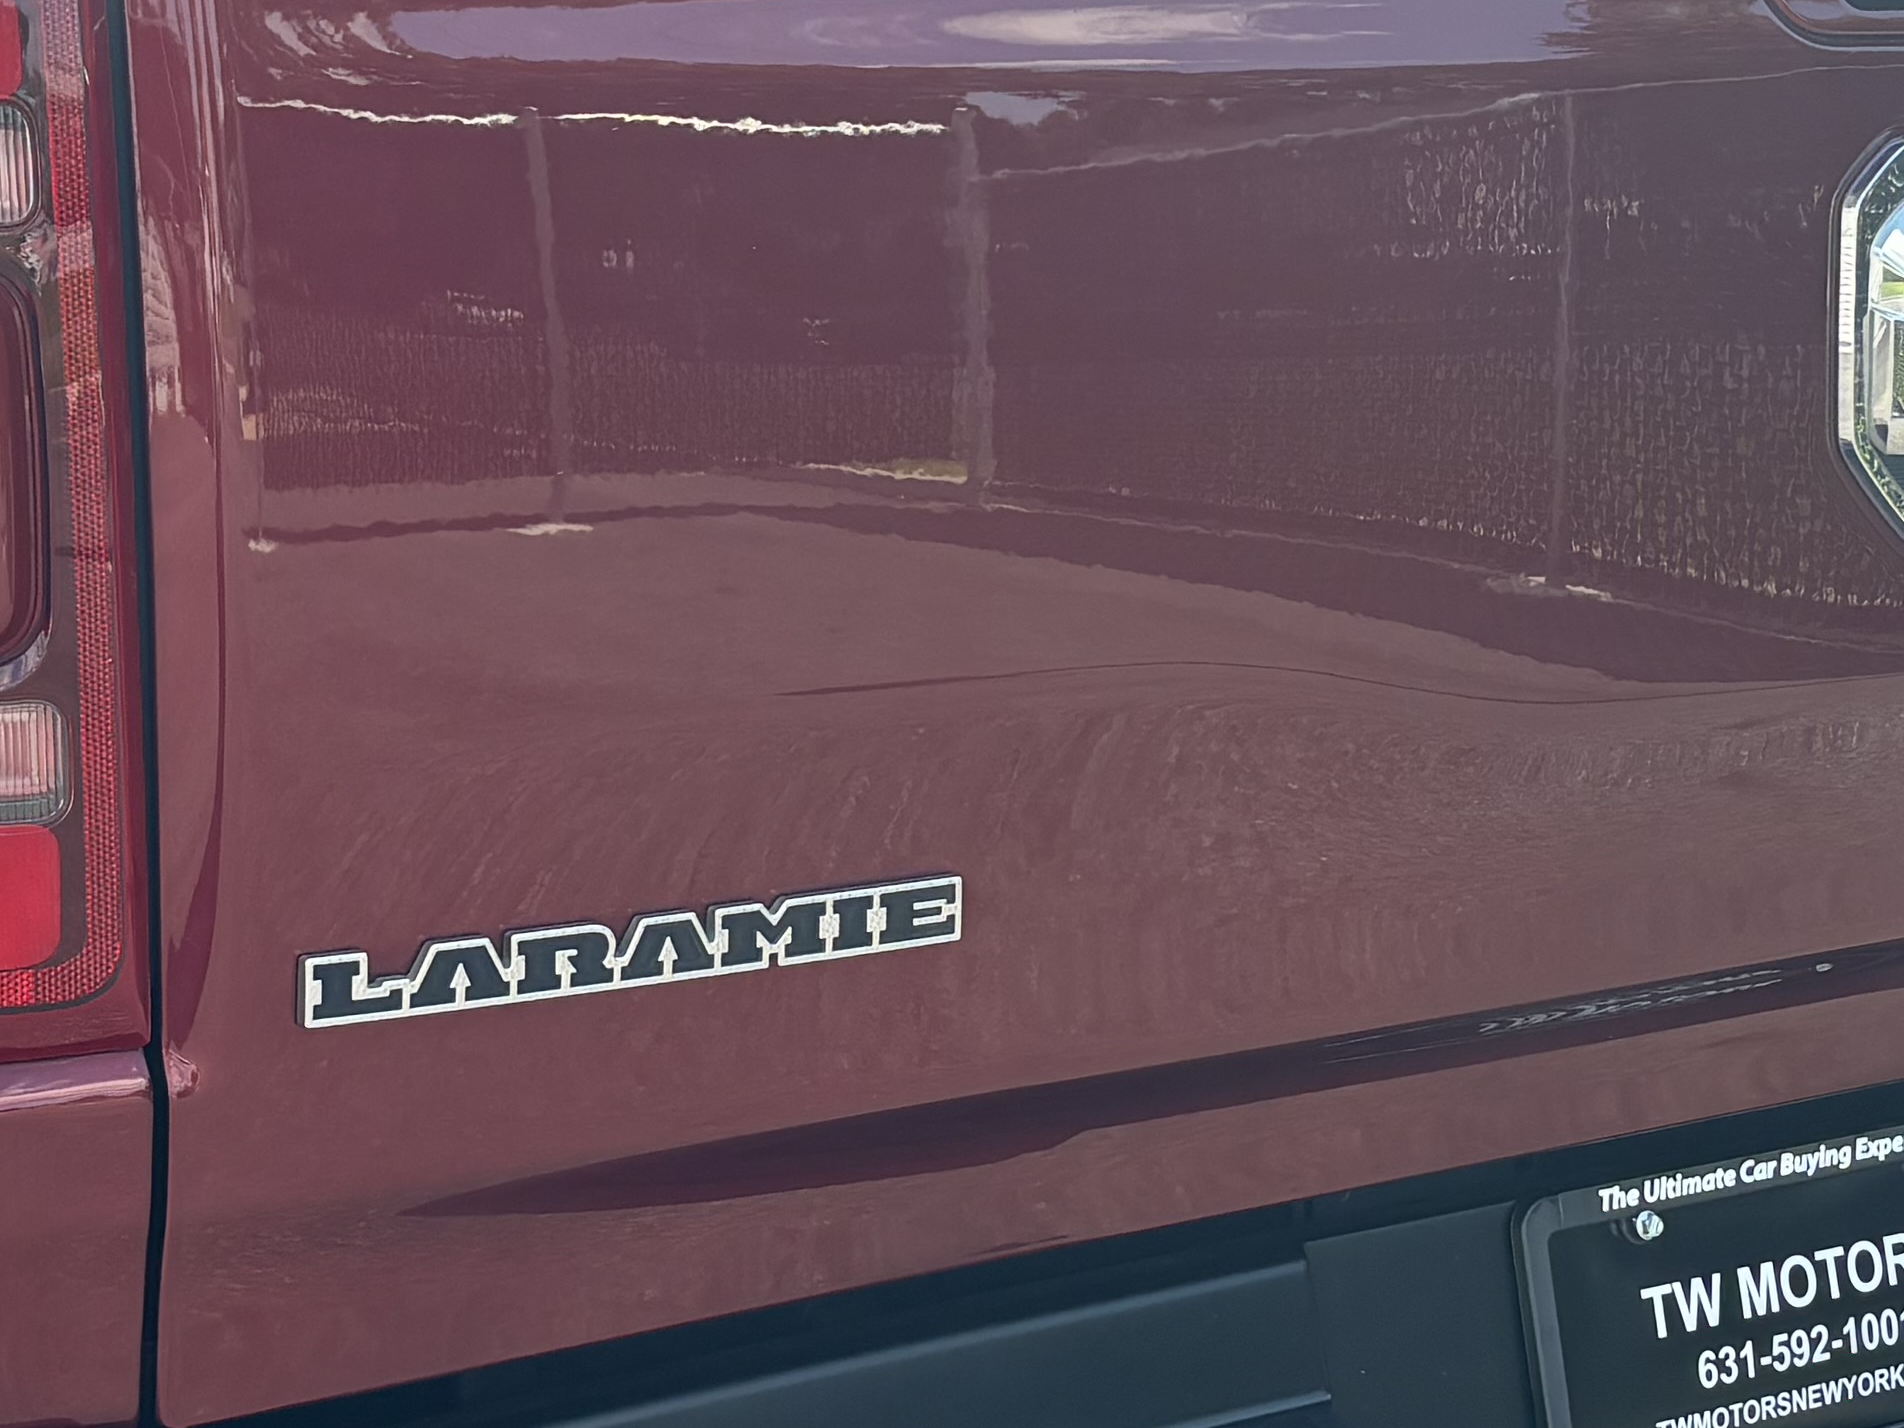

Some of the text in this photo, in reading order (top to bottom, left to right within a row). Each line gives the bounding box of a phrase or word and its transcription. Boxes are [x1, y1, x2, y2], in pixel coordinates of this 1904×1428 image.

[299, 875, 963, 1029] LARAMIE
[1598, 1185, 1641, 1213] The
[1643, 1167, 1737, 1204] Ultimate
[1739, 1158, 1778, 1184] Car
[1779, 1143, 1852, 1177] Buying
[1640, 1272, 1721, 1339] TW
